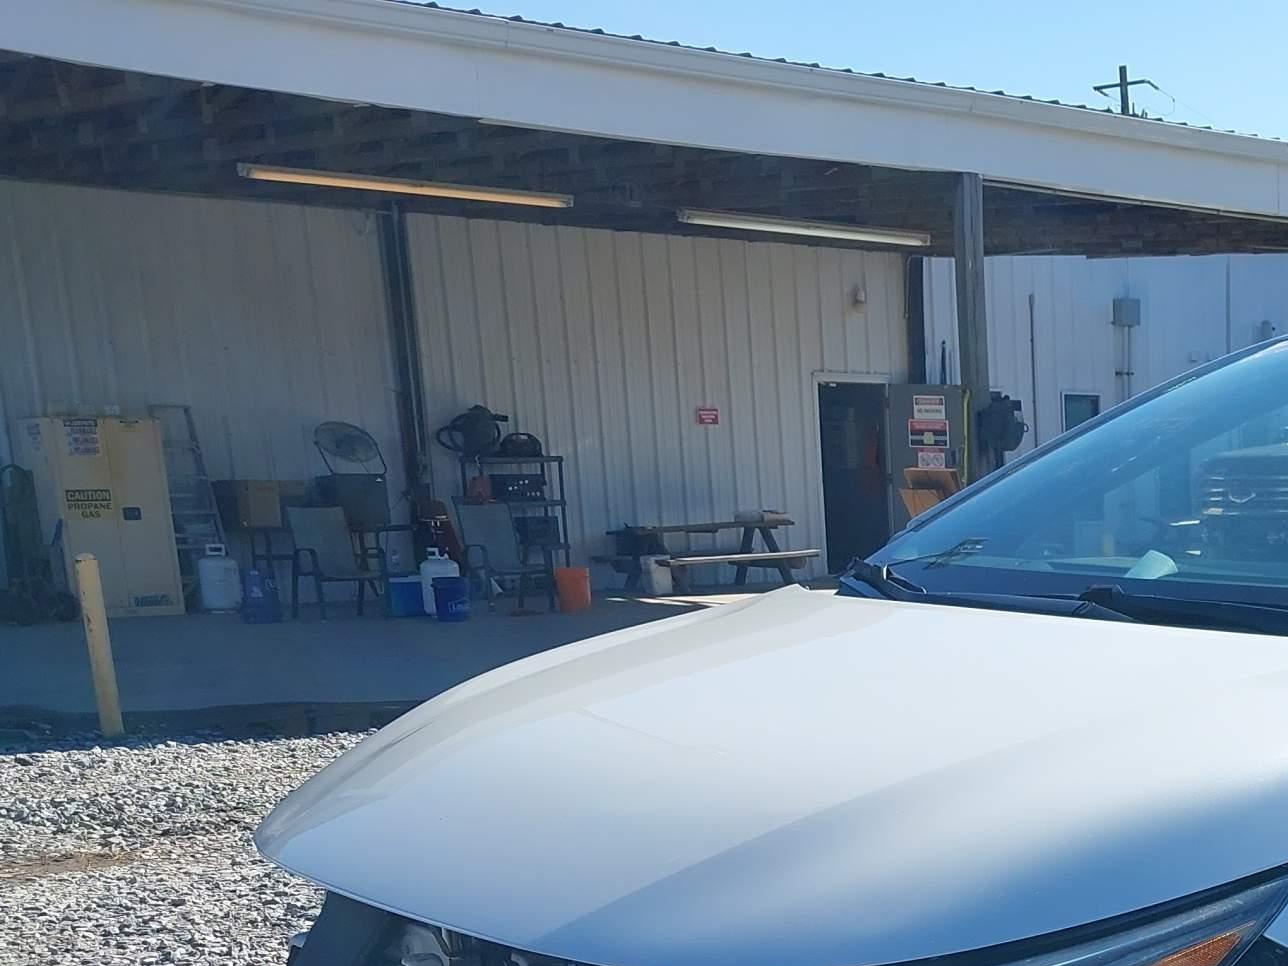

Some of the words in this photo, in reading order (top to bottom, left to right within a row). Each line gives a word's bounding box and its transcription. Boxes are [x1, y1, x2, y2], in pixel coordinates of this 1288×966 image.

[67, 491, 110, 501] CAUTION
[67, 502, 112, 510] PROPANE
[81, 510, 101, 518] GAS
